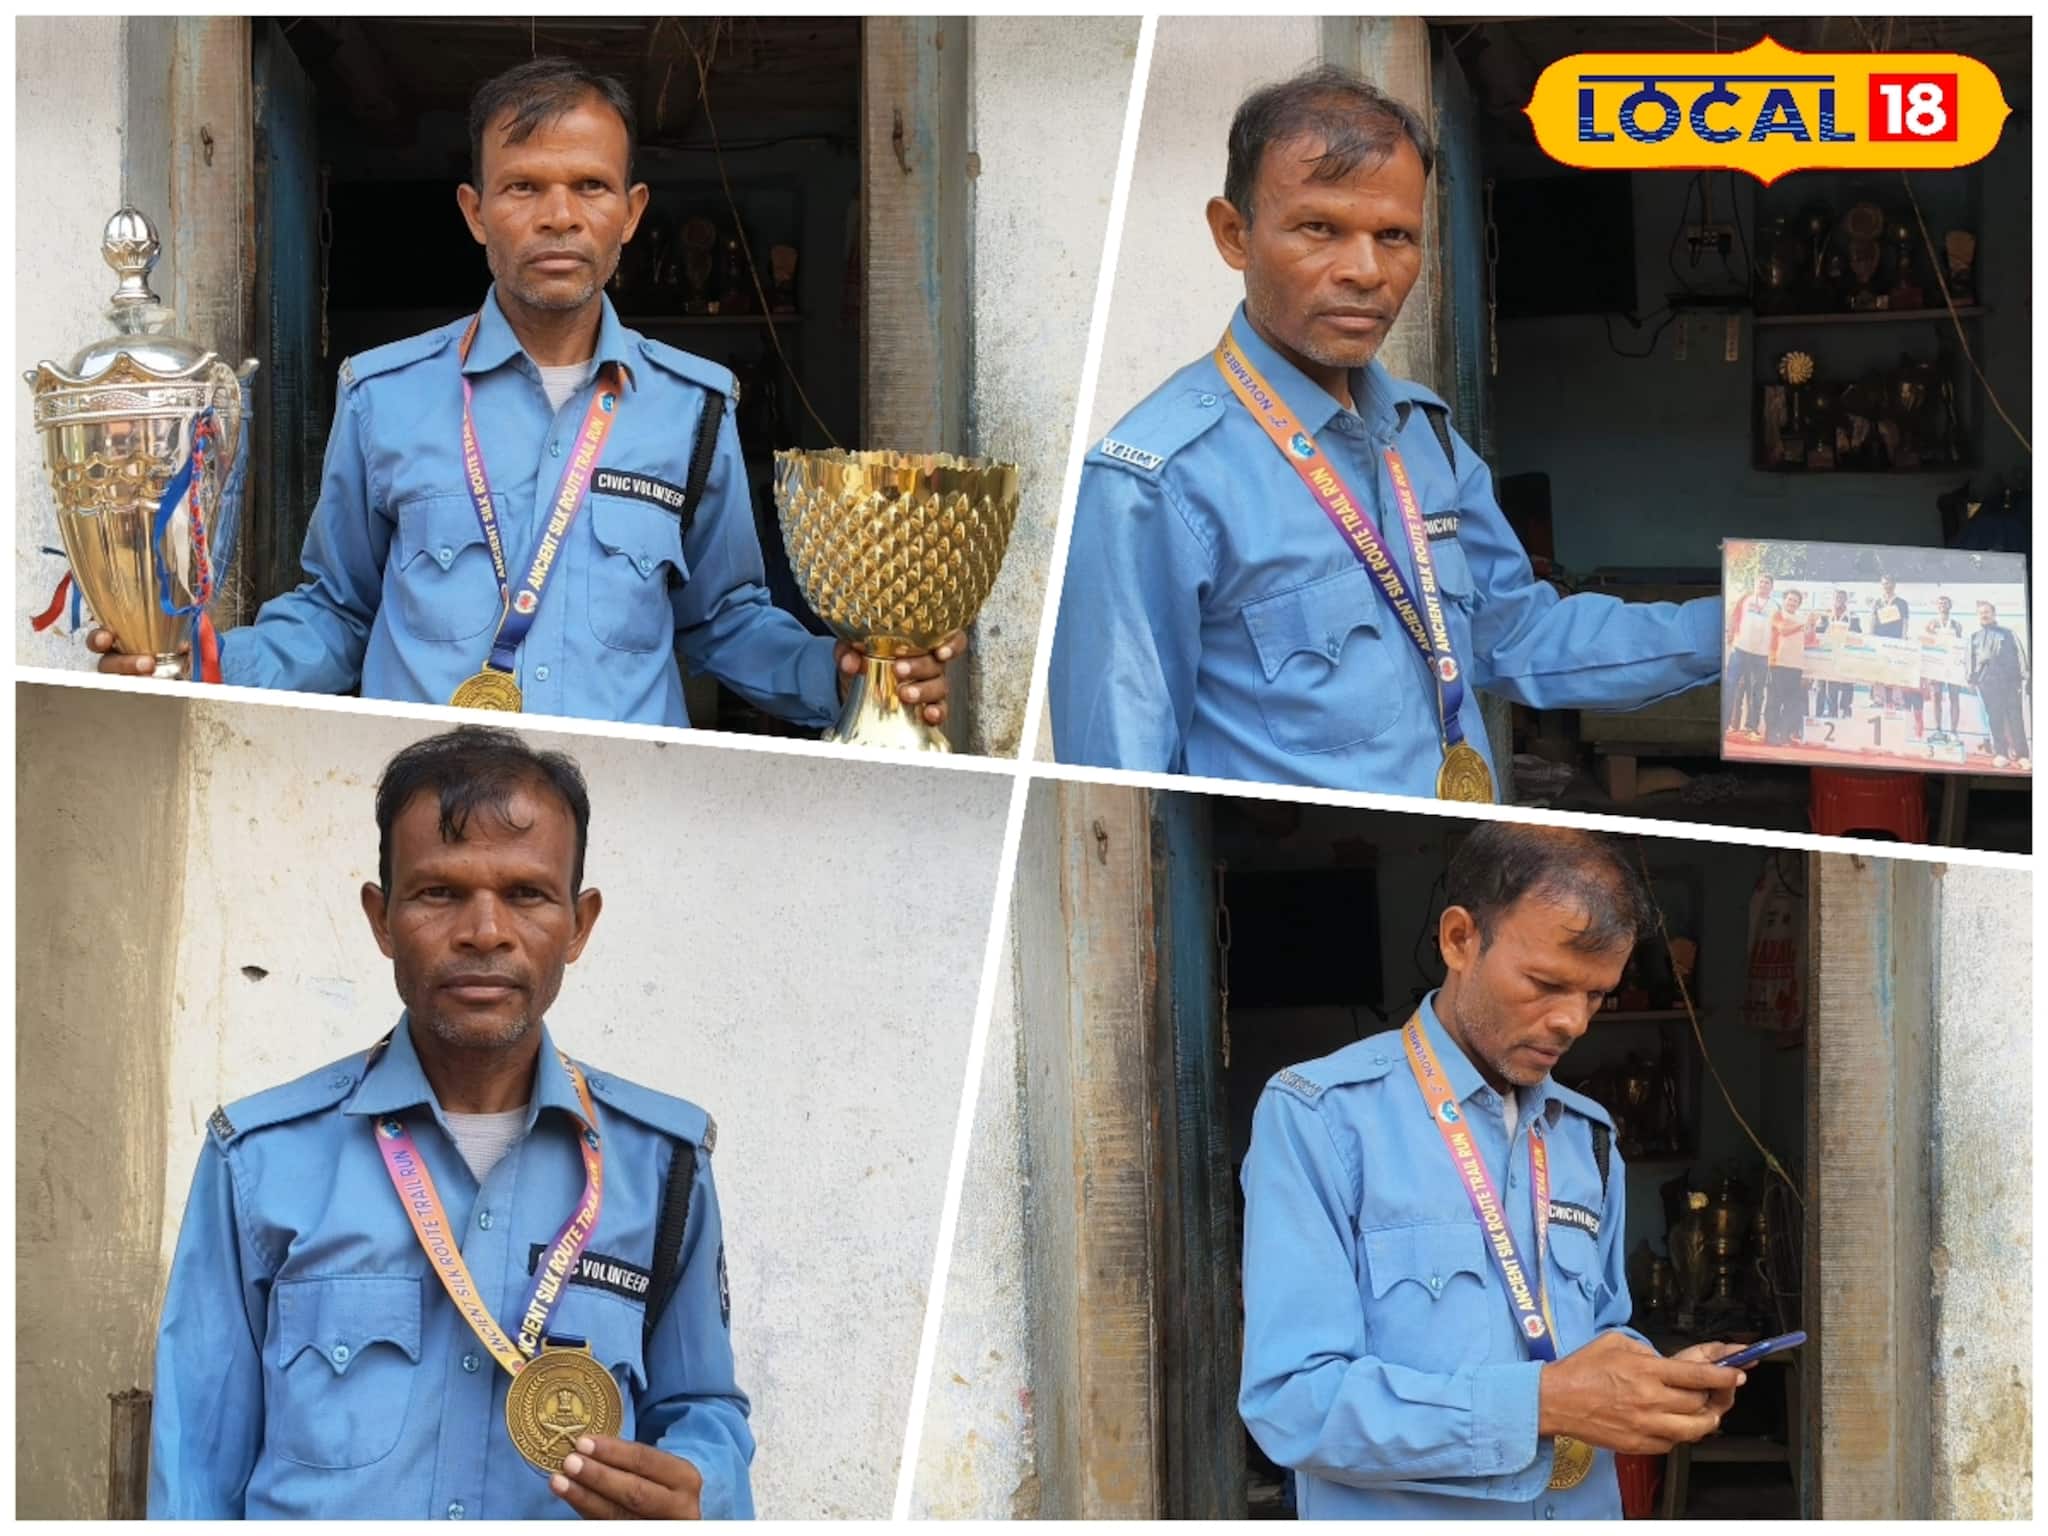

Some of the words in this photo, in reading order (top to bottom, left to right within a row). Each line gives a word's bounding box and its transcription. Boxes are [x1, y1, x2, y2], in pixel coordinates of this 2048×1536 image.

[467, 453, 487, 495] ROUTE
[598, 473, 632, 492] CIVIC
[1309, 467, 1340, 497] RUN
[477, 496, 493, 523] SILK
[527, 532, 559, 590] ANCIENT
[548, 505, 571, 536] SILK
[560, 473, 584, 509] ROUTE
[574, 444, 597, 474] TRAIL
[586, 417, 605, 444] RUN
[1330, 493, 1363, 531] TRAIL
[1352, 528, 1389, 573] ROUTE
[1409, 522, 1428, 565] ROUTE
[1377, 567, 1403, 599] SILK
[1419, 565, 1436, 594] SILK
[1394, 597, 1433, 653] ANCIENT
[1424, 595, 1451, 653] ANCIENT
[1824, 721, 1835, 742] 2
[1867, 716, 1882, 746] 1
[393, 1150, 417, 1177] RUN
[1452, 1133, 1472, 1159] RUN
[1464, 1160, 1486, 1191] TRAIL
[406, 1179, 432, 1217] TRAIL
[1476, 1191, 1504, 1231] ROUTE
[422, 1219, 454, 1266] ROUTE
[1491, 1232, 1513, 1257] SILK
[536, 1272, 560, 1303] SILK
[549, 1225, 583, 1273] ROUTE
[582, 1259, 650, 1294] VOLUNTEER
[448, 1270, 470, 1300] SILK
[1502, 1259, 1536, 1311] ANCIENT
[464, 1302, 510, 1354] ANCIENT
